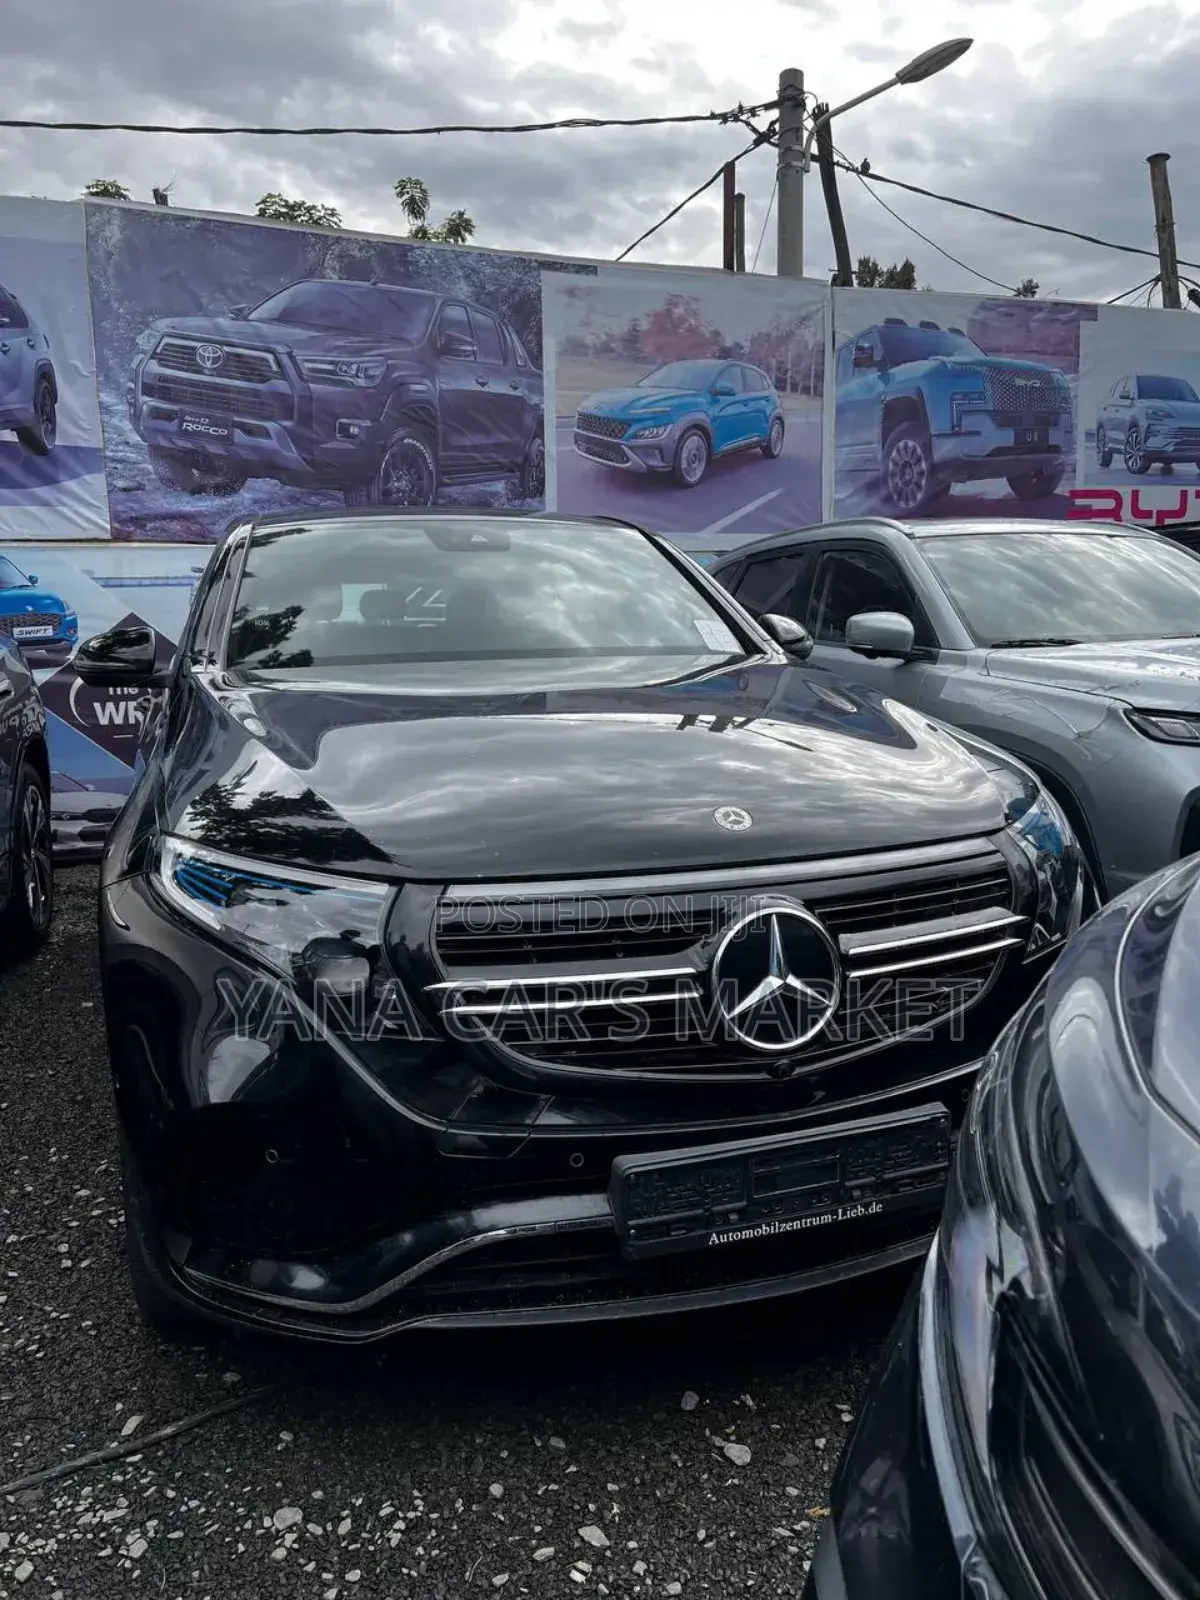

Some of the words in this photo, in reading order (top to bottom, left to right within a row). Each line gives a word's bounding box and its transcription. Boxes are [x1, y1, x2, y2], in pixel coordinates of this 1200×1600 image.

[182, 422, 228, 436] ROCCO
[15, 627, 50, 636] SWIFT
[708, 1202, 884, 1246] Automobilzentrum-Lieb.de
